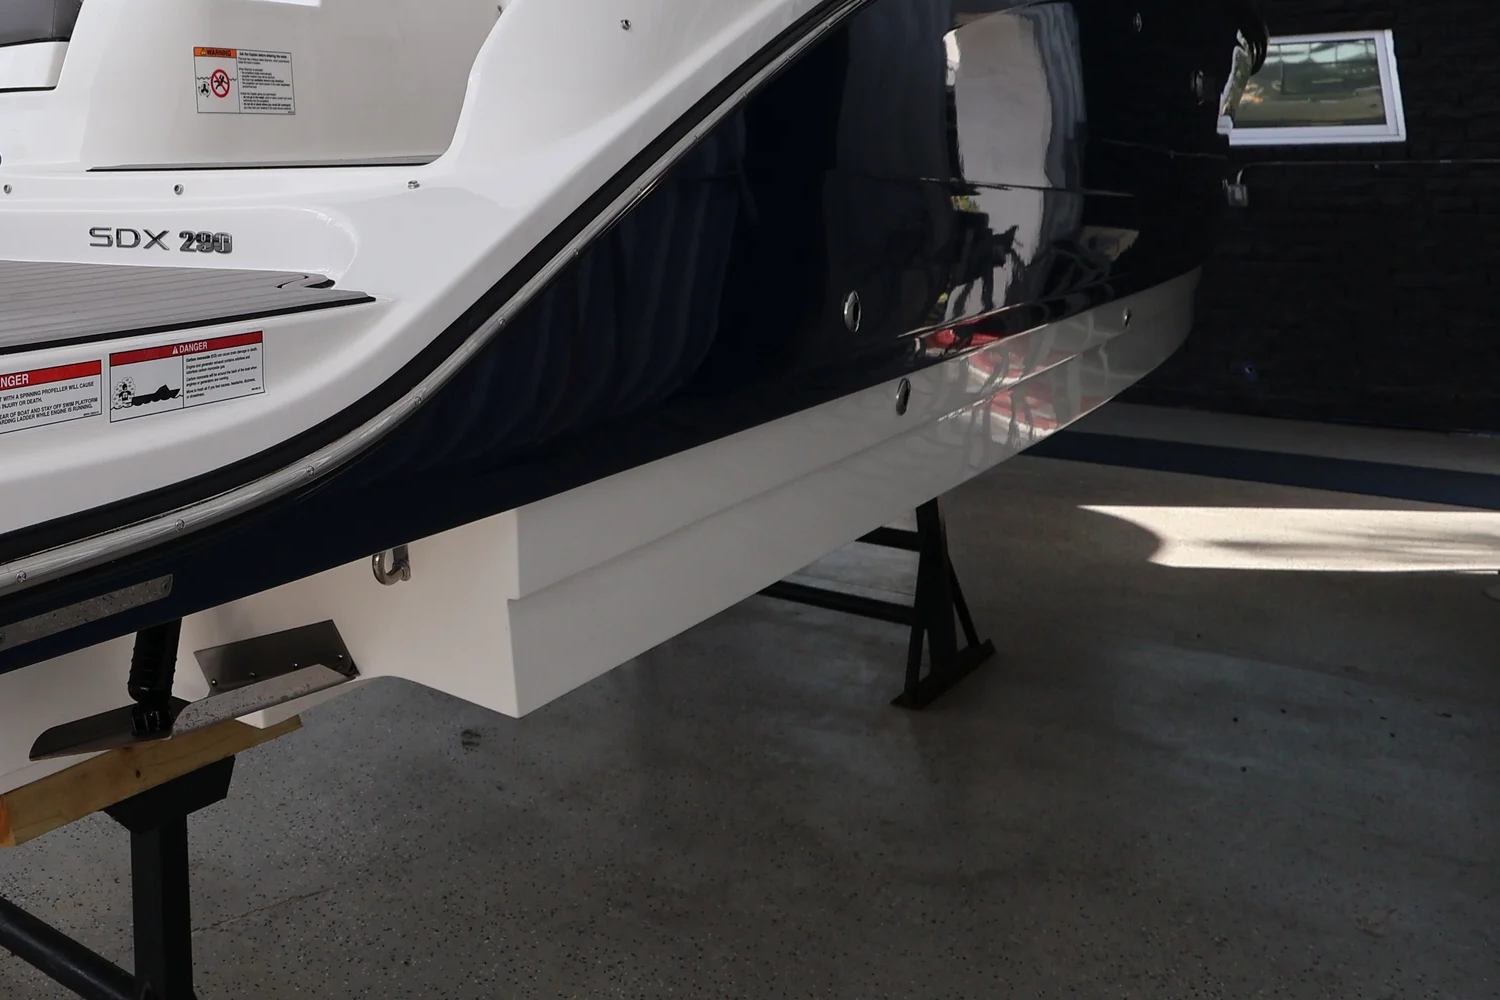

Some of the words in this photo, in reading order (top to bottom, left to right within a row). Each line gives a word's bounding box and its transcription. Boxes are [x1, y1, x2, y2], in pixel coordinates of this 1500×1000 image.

[207, 49, 231, 57] WARNING
[89, 226, 170, 250] SDX
[179, 230, 233, 254] 290
[179, 342, 208, 353] DANGER
[20, 391, 41, 399] SPINNING
[42, 386, 68, 395] PROPELLER
[80, 381, 94, 389] CAUSE
[27, 397, 43, 405] DEATH.
[75, 398, 98, 406] PLATFORM
